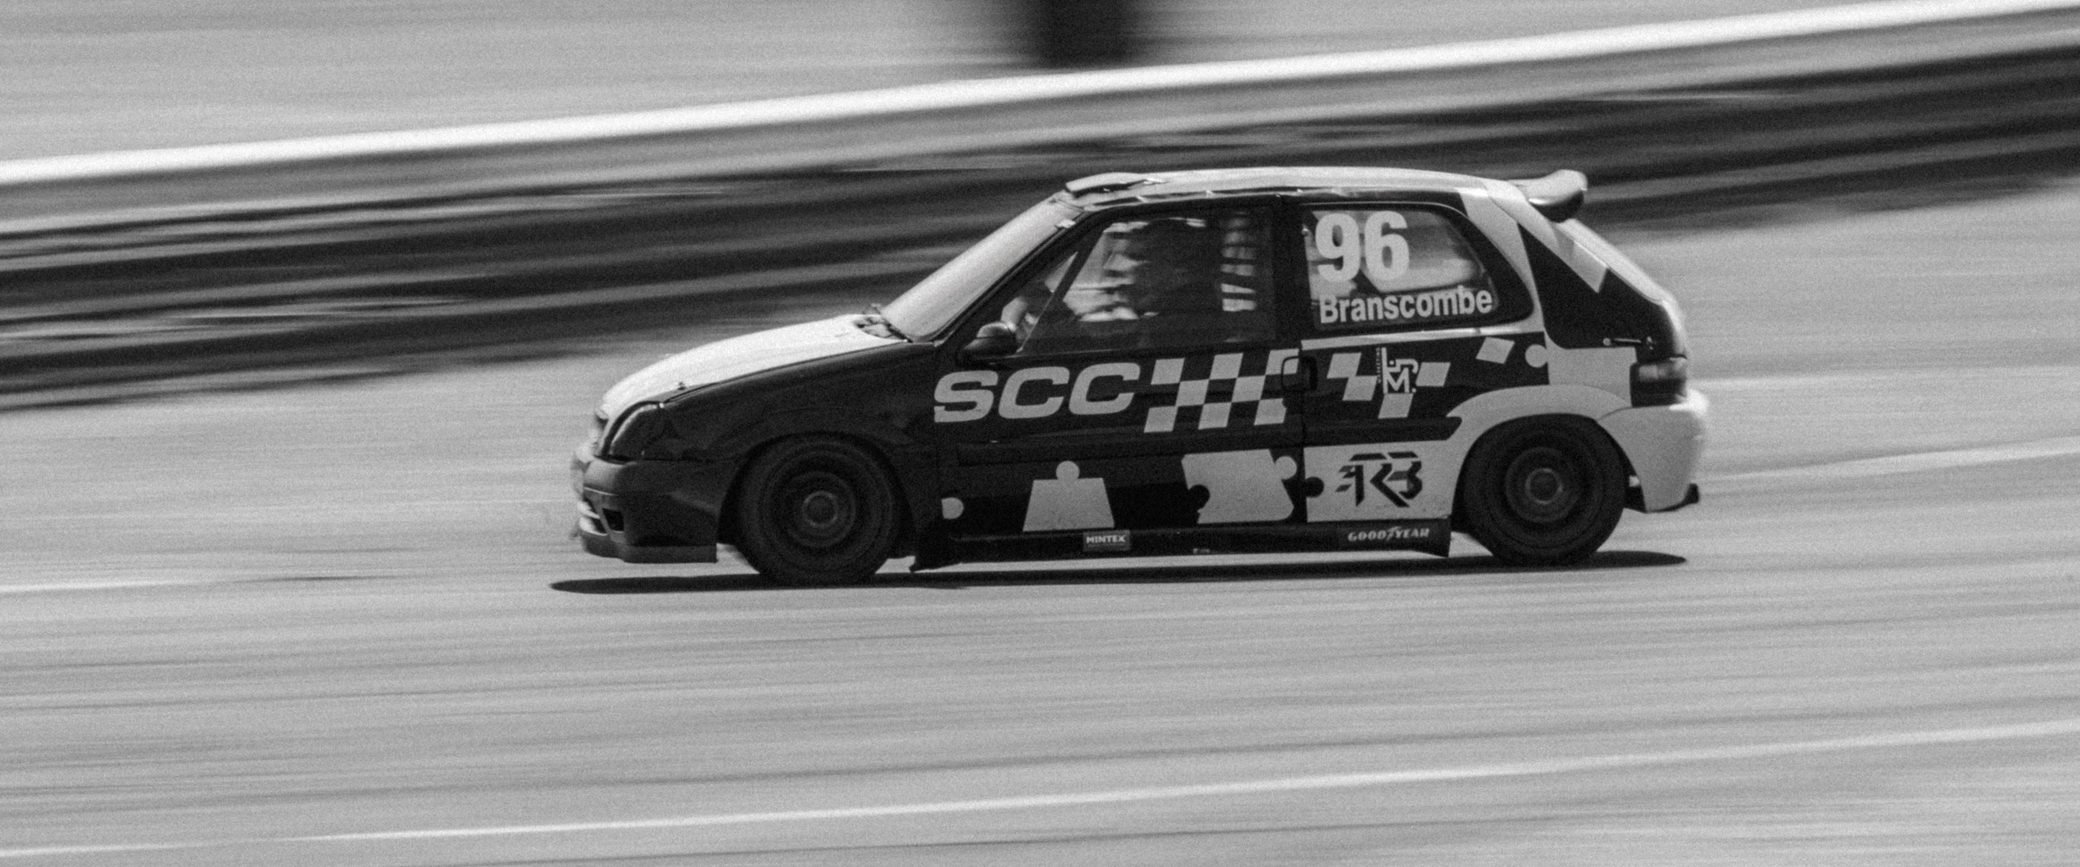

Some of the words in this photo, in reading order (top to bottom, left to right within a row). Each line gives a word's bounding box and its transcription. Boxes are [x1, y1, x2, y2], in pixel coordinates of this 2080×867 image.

[1315, 210, 1410, 282] 96
[1319, 285, 1493, 323] Branscombe
[934, 362, 1141, 423] SCC
[1085, 534, 1127, 545] MINTEX
[1347, 526, 1430, 542] GOODYEAR
